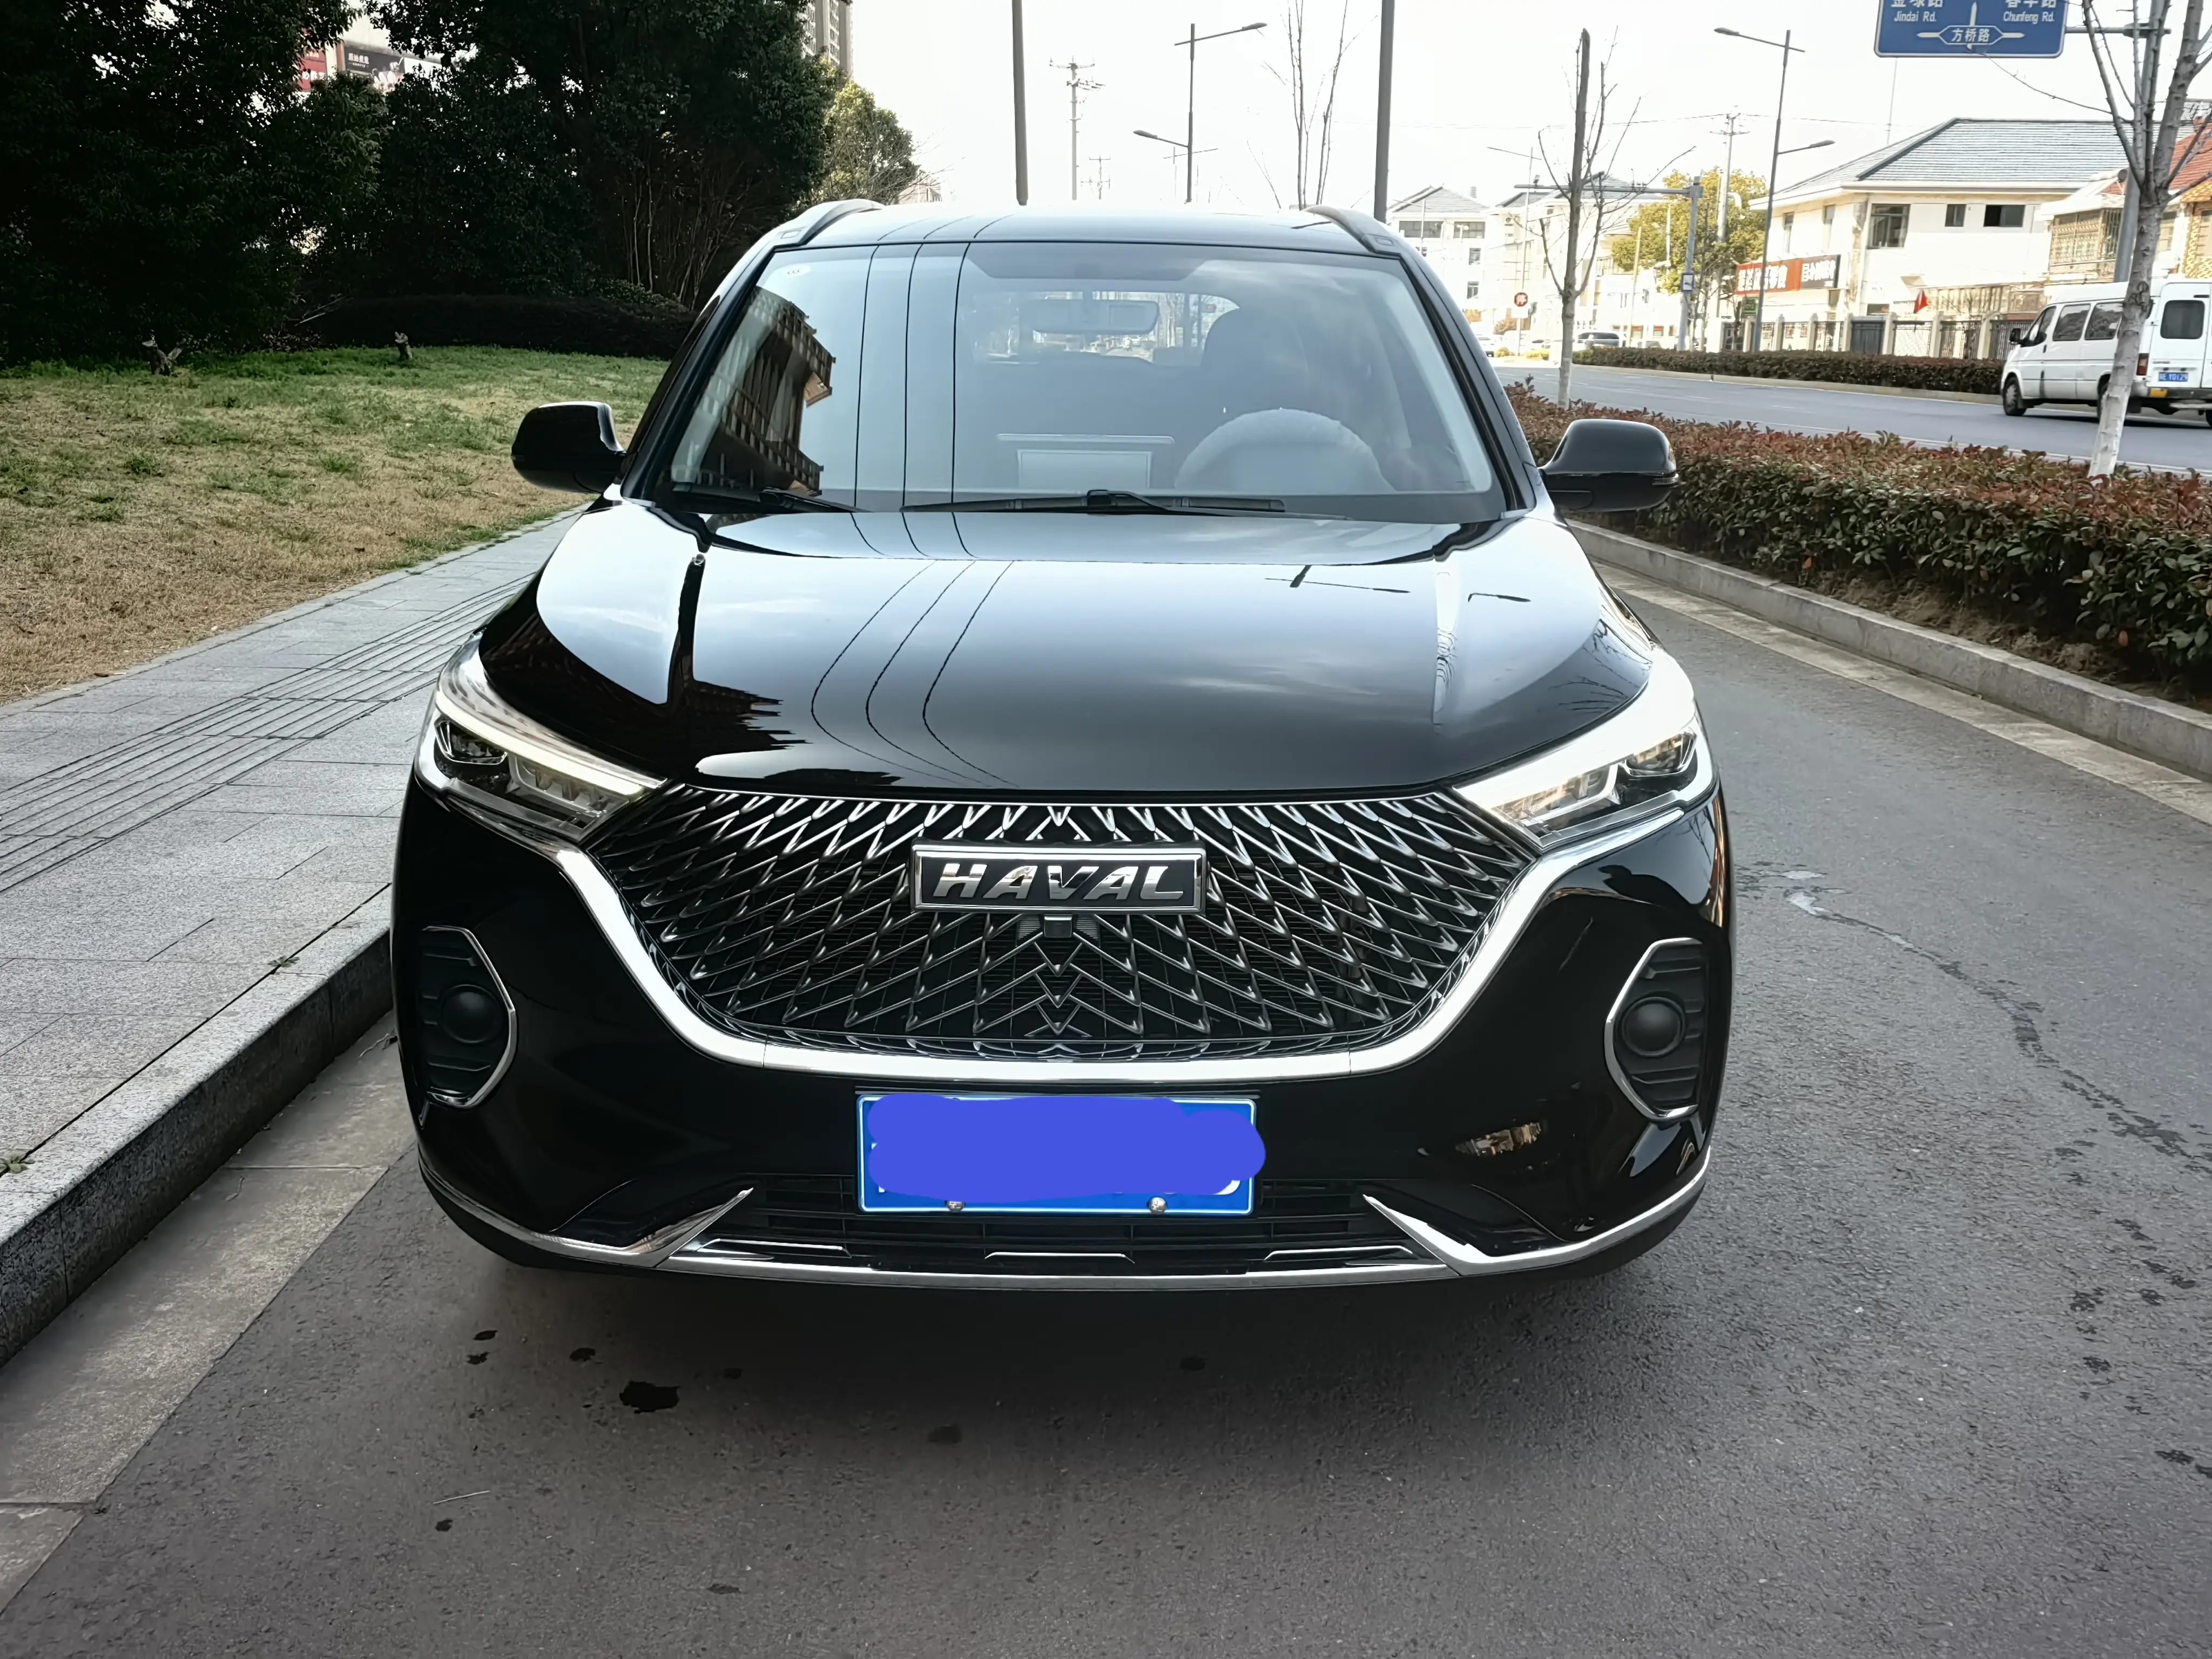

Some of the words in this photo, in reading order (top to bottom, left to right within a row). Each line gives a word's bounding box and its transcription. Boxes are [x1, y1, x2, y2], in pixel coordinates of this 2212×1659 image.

[1894, 11, 1919, 22] Jindai
[1923, 11, 1937, 22] Rd.
[2003, 11, 2039, 24] Chunfeng
[2041, 11, 2055, 22] Rd.
[1951, 28, 1990, 42] 方桥路
[932, 863, 1184, 901] HAVAL
